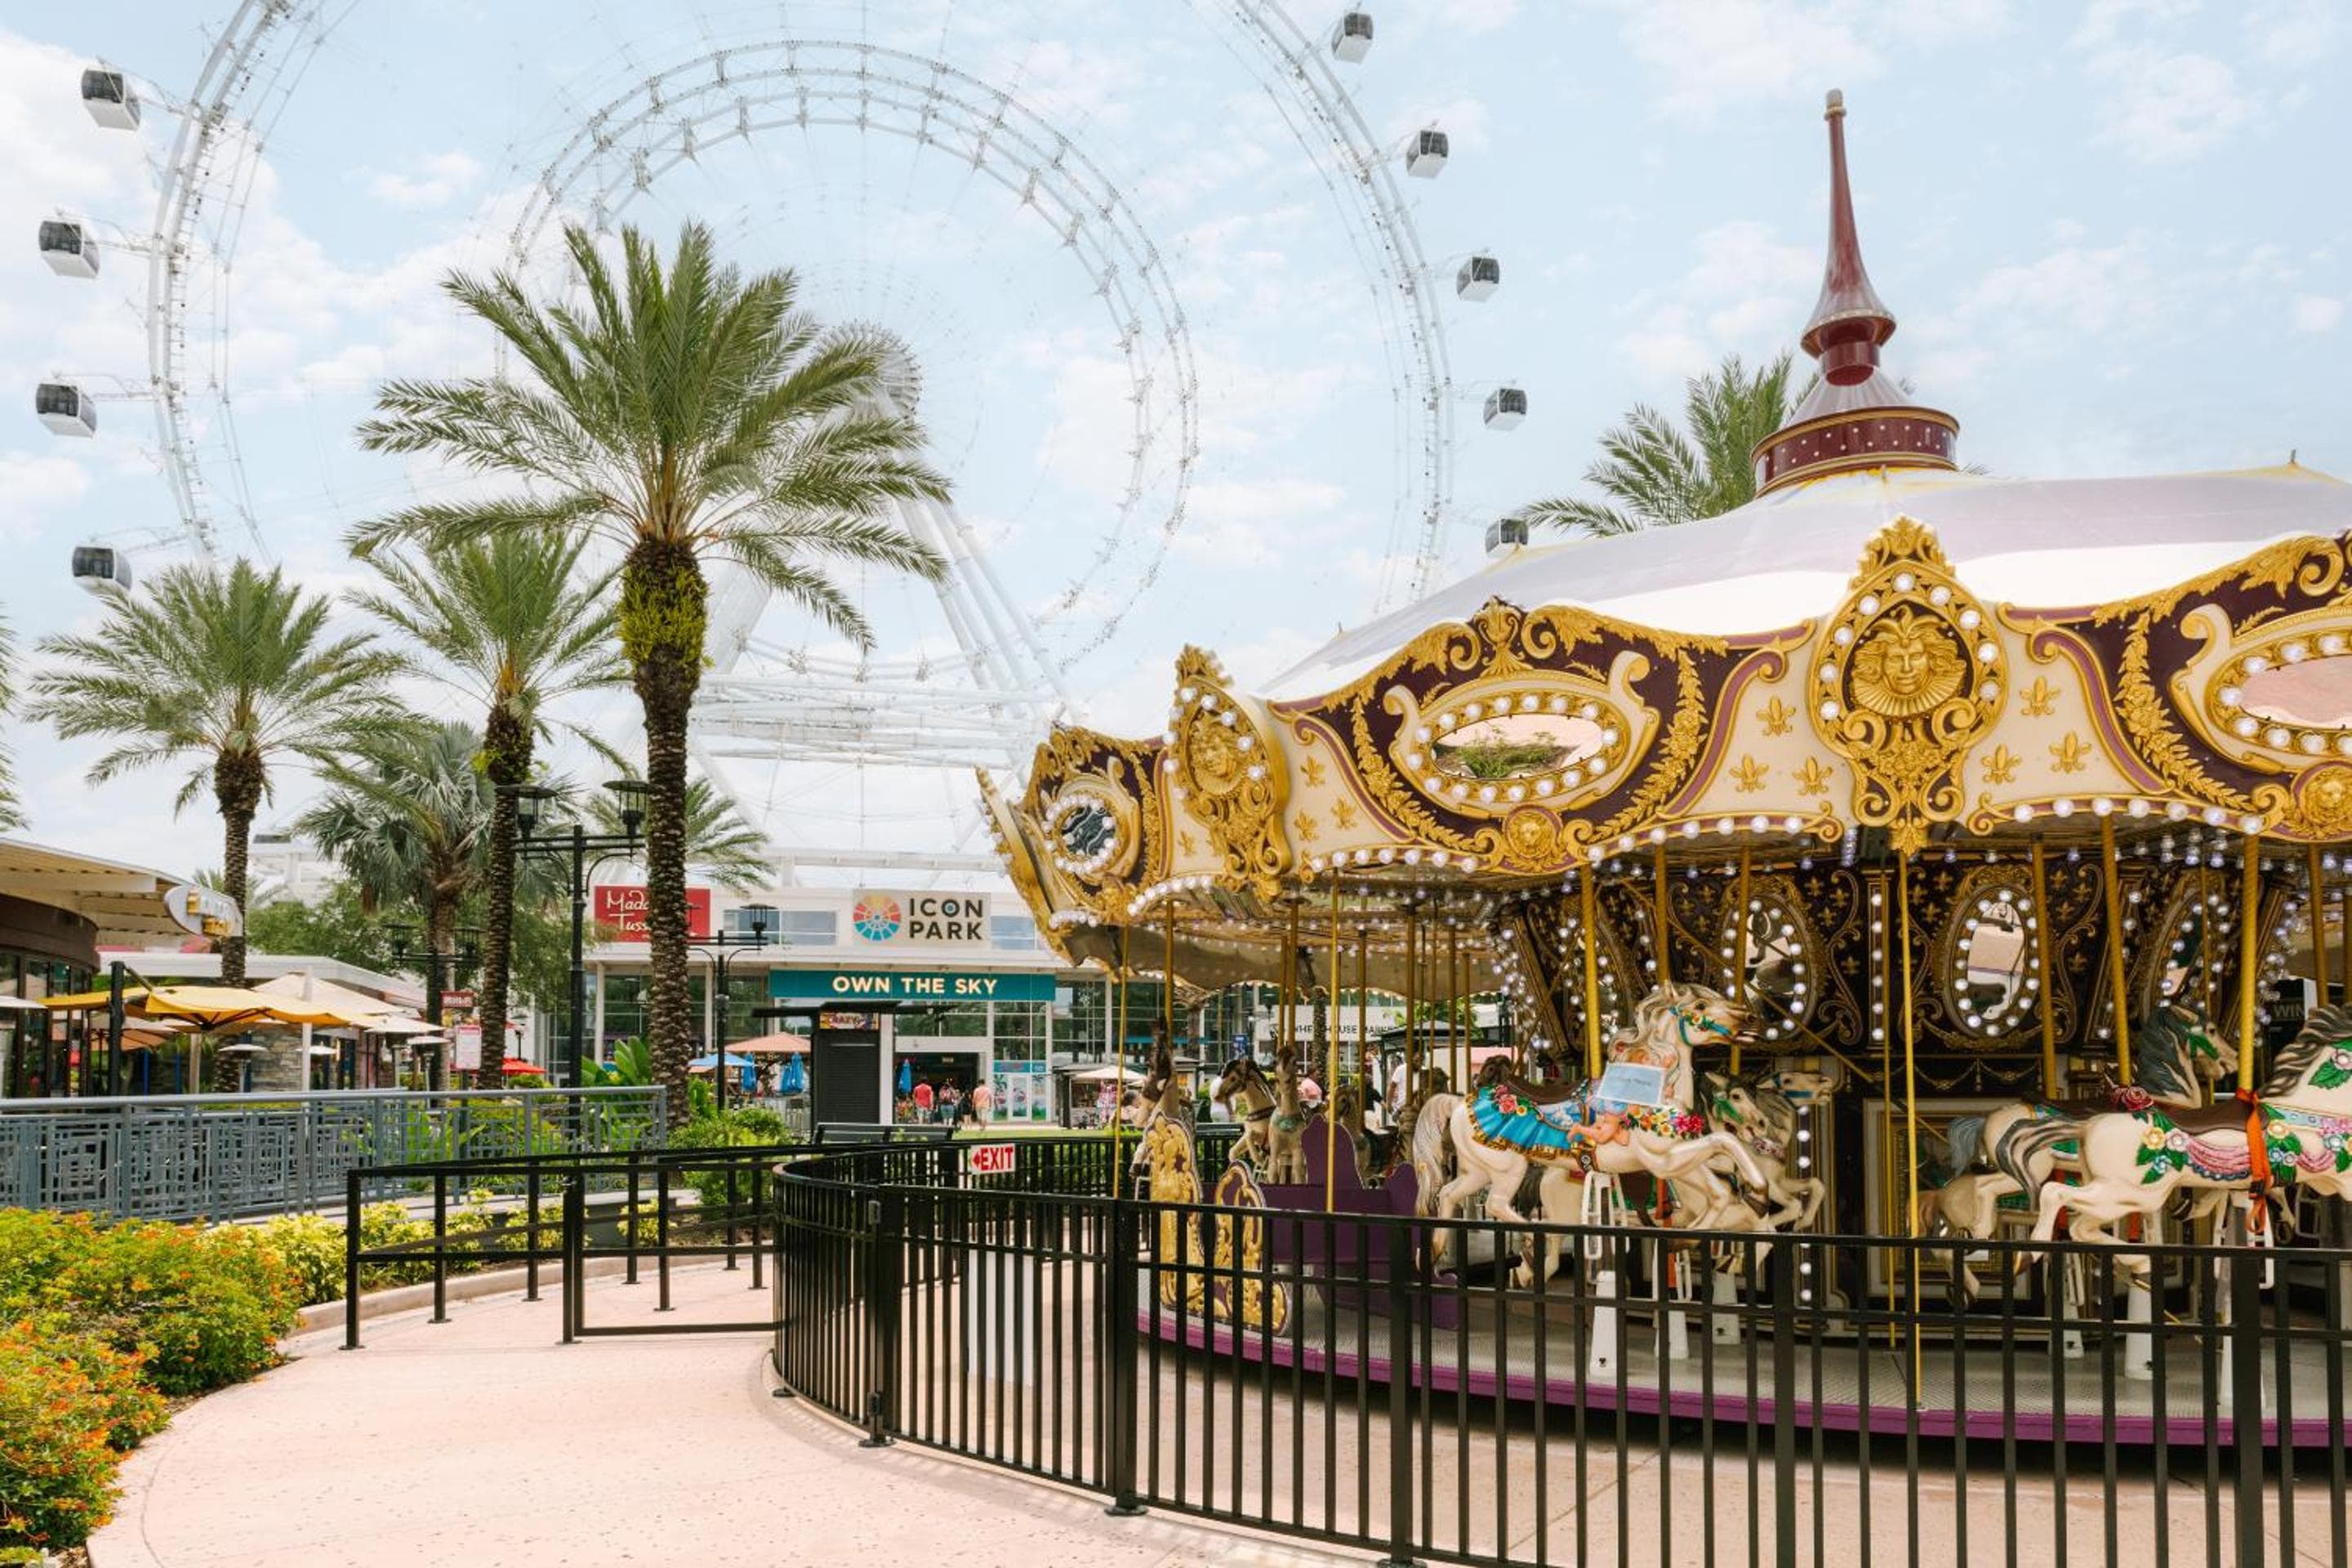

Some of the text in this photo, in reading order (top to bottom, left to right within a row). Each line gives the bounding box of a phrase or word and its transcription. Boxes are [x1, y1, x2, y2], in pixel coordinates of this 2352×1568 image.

[909, 898, 983, 917] ICON
[909, 920, 982, 939] PARK
[832, 976, 997, 994] OWN THE SKY
[980, 1147, 1013, 1170] EXIT
